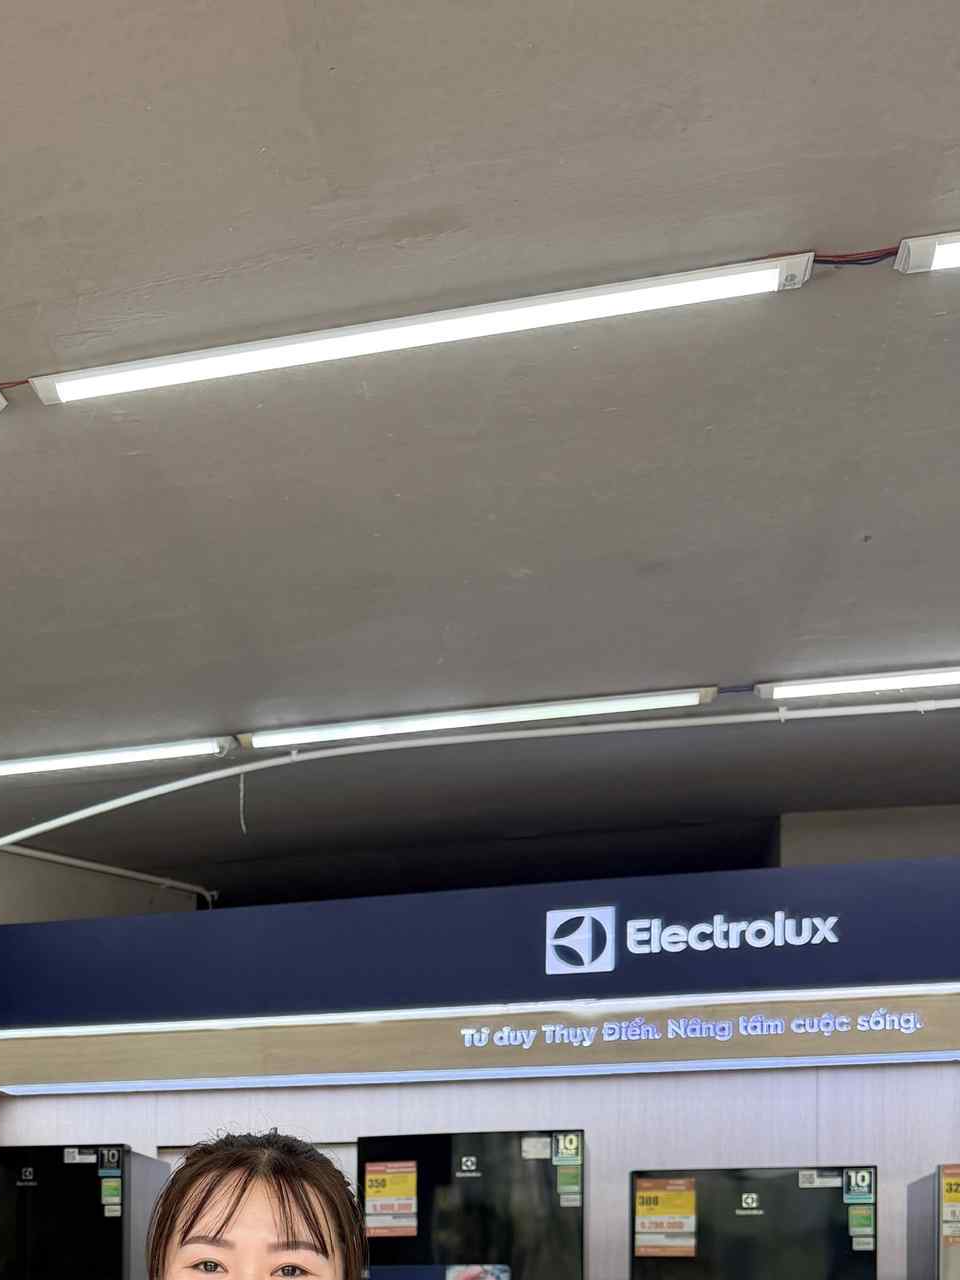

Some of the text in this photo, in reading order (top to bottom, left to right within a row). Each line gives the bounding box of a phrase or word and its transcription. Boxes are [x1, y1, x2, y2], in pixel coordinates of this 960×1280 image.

[626, 910, 839, 954] Electrolux
[460, 1008, 923, 1049] Tư duy Thụy Điển. Nâng tầm cuộc sống.
[103, 1150, 119, 1163] 10
[847, 1170, 871, 1187] 10
